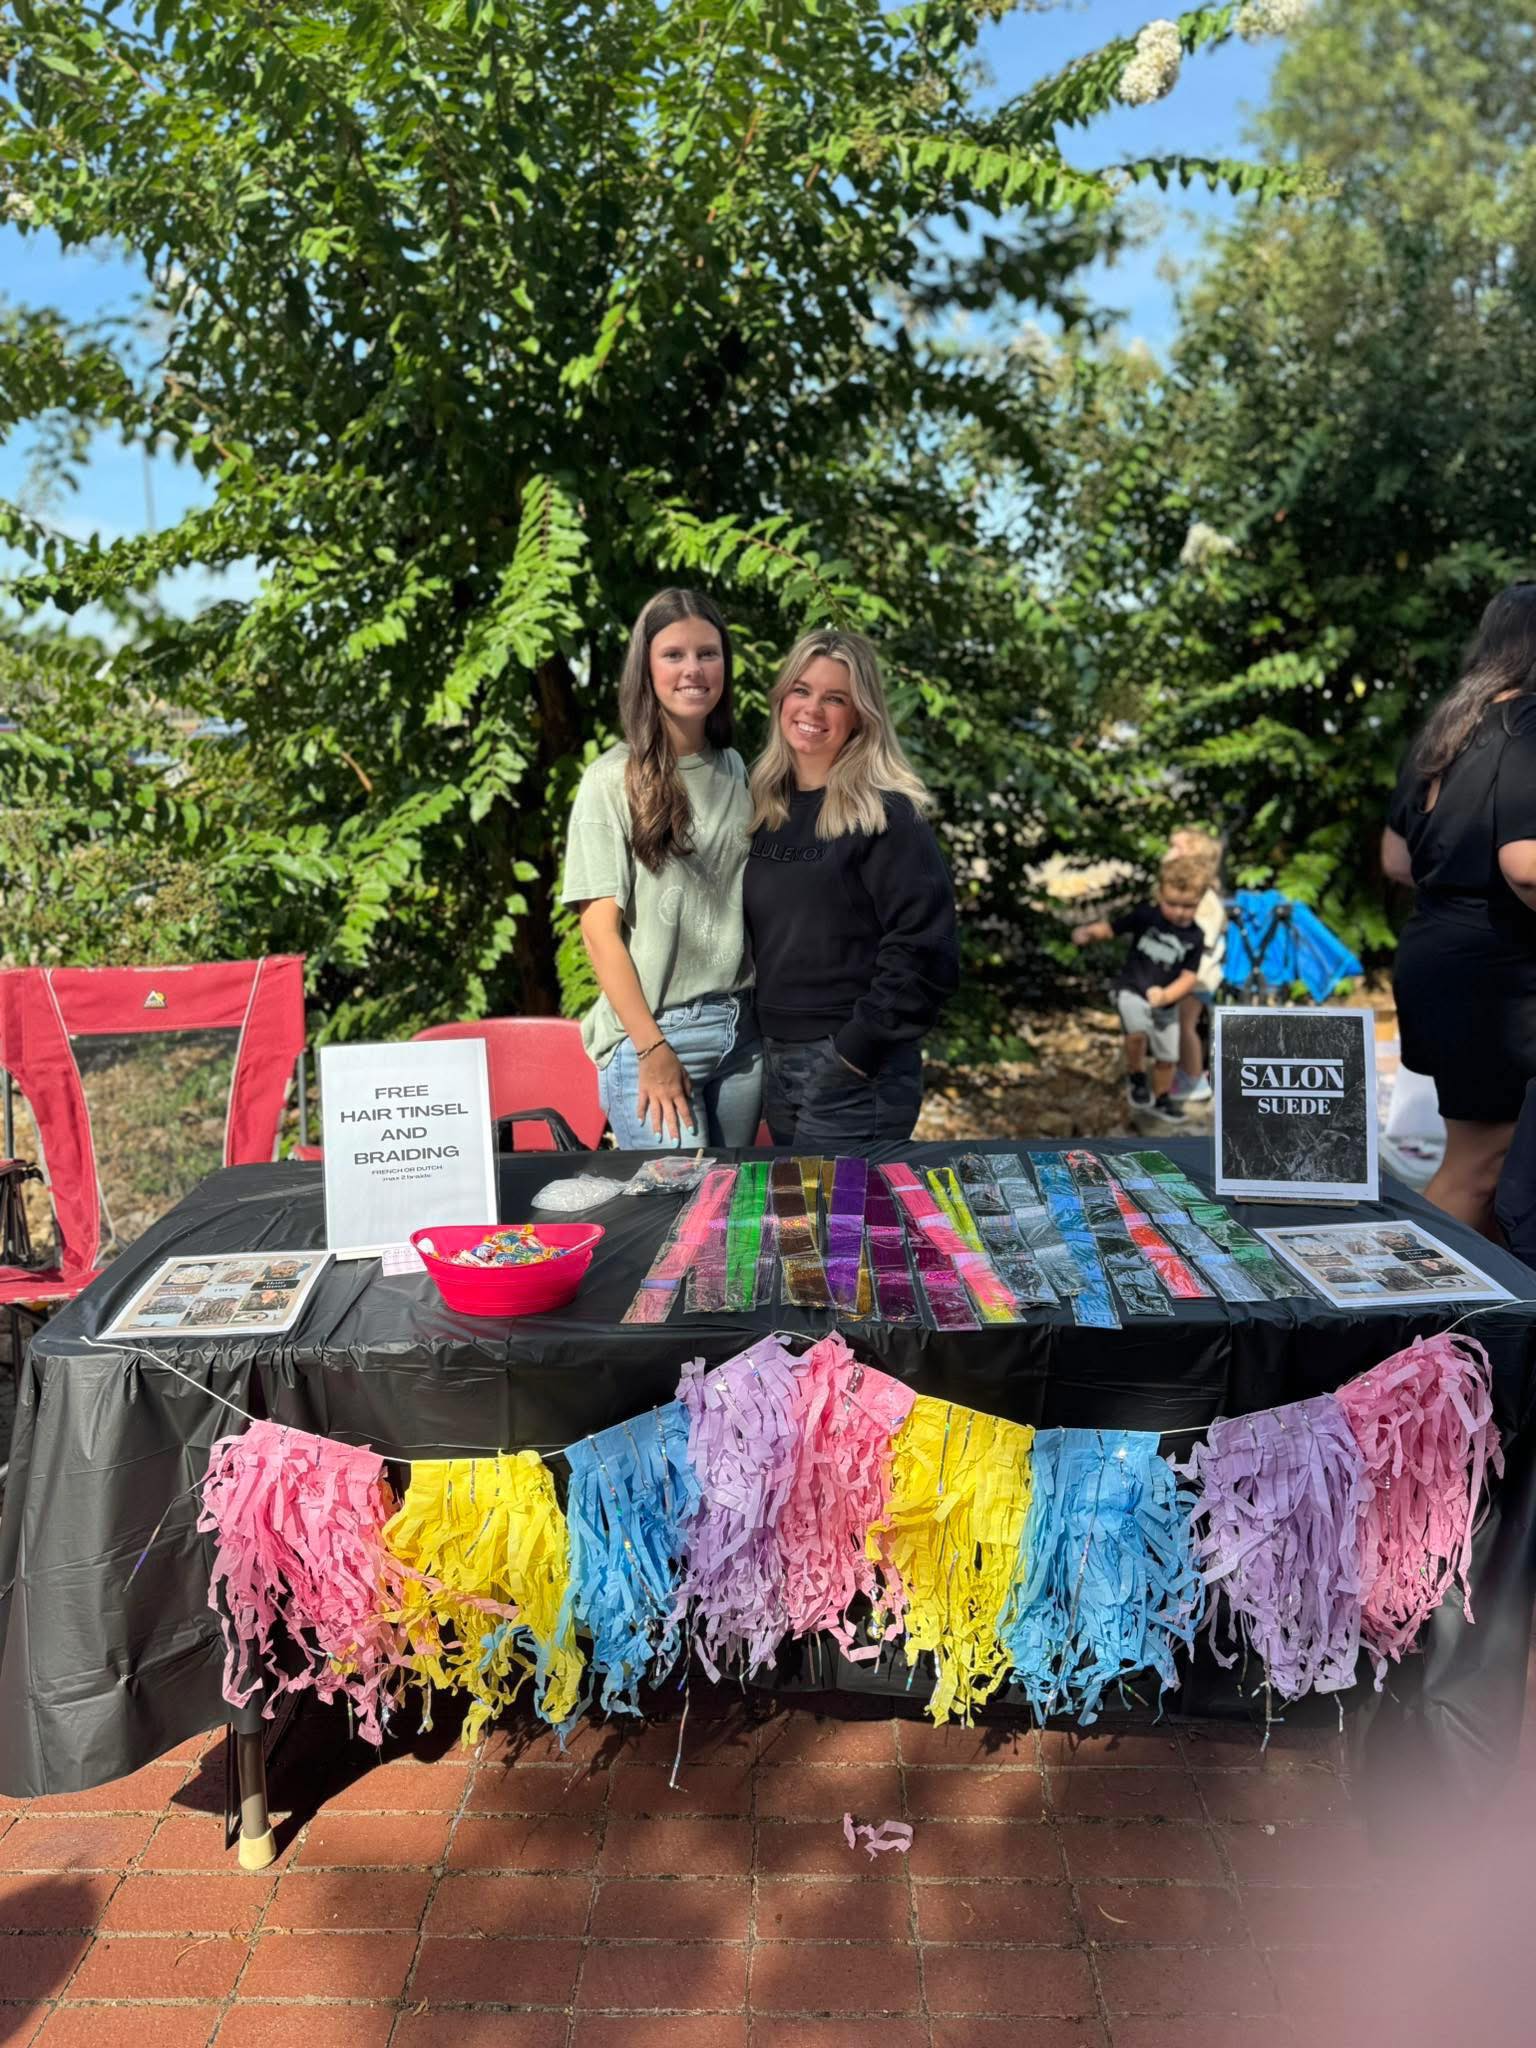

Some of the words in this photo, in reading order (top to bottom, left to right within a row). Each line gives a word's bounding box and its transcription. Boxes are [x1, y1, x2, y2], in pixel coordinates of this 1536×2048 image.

[750, 840, 827, 862] LULEO
[1240, 1065, 1344, 1089] SALON
[374, 1084, 429, 1100] FREE
[340, 1108, 392, 1123] HAIR
[396, 1103, 469, 1119] TINSEL
[1258, 1097, 1331, 1115] SUEDE
[380, 1126, 428, 1142] AND
[354, 1145, 460, 1165] BRAIDING
